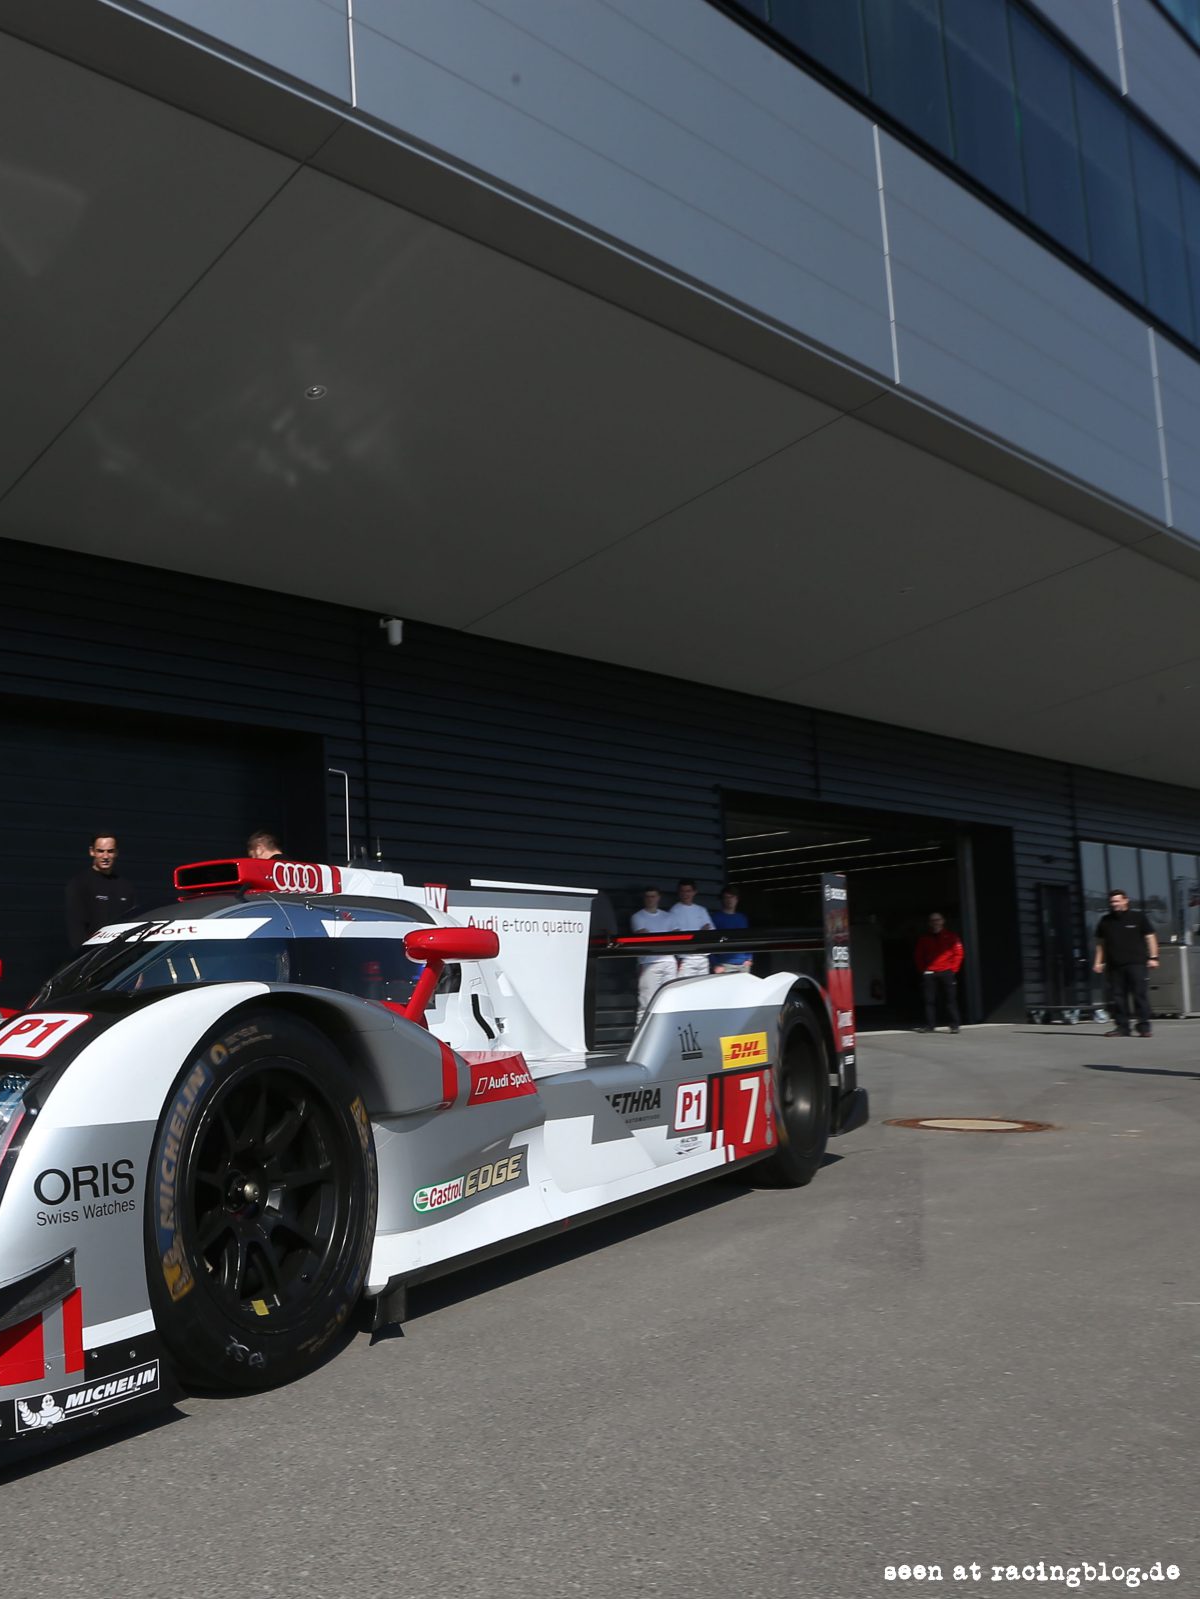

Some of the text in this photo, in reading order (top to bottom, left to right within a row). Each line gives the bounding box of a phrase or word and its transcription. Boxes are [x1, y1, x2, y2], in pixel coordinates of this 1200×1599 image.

[468, 915, 584, 936] Audi e-tron quattro
[730, 1040, 762, 1059] DHL
[488, 1072, 532, 1090] Audi Sport
[605, 1088, 661, 1114] ETHRA
[680, 1089, 701, 1123] P1
[739, 1076, 760, 1144] 7
[159, 1065, 207, 1230] MICHELIN
[33, 1159, 135, 1206] ORIS
[429, 1153, 523, 1207] Castrol EDGE
[36, 1200, 136, 1226] Swiss Watches
[65, 1367, 157, 1410] MICHELIN
